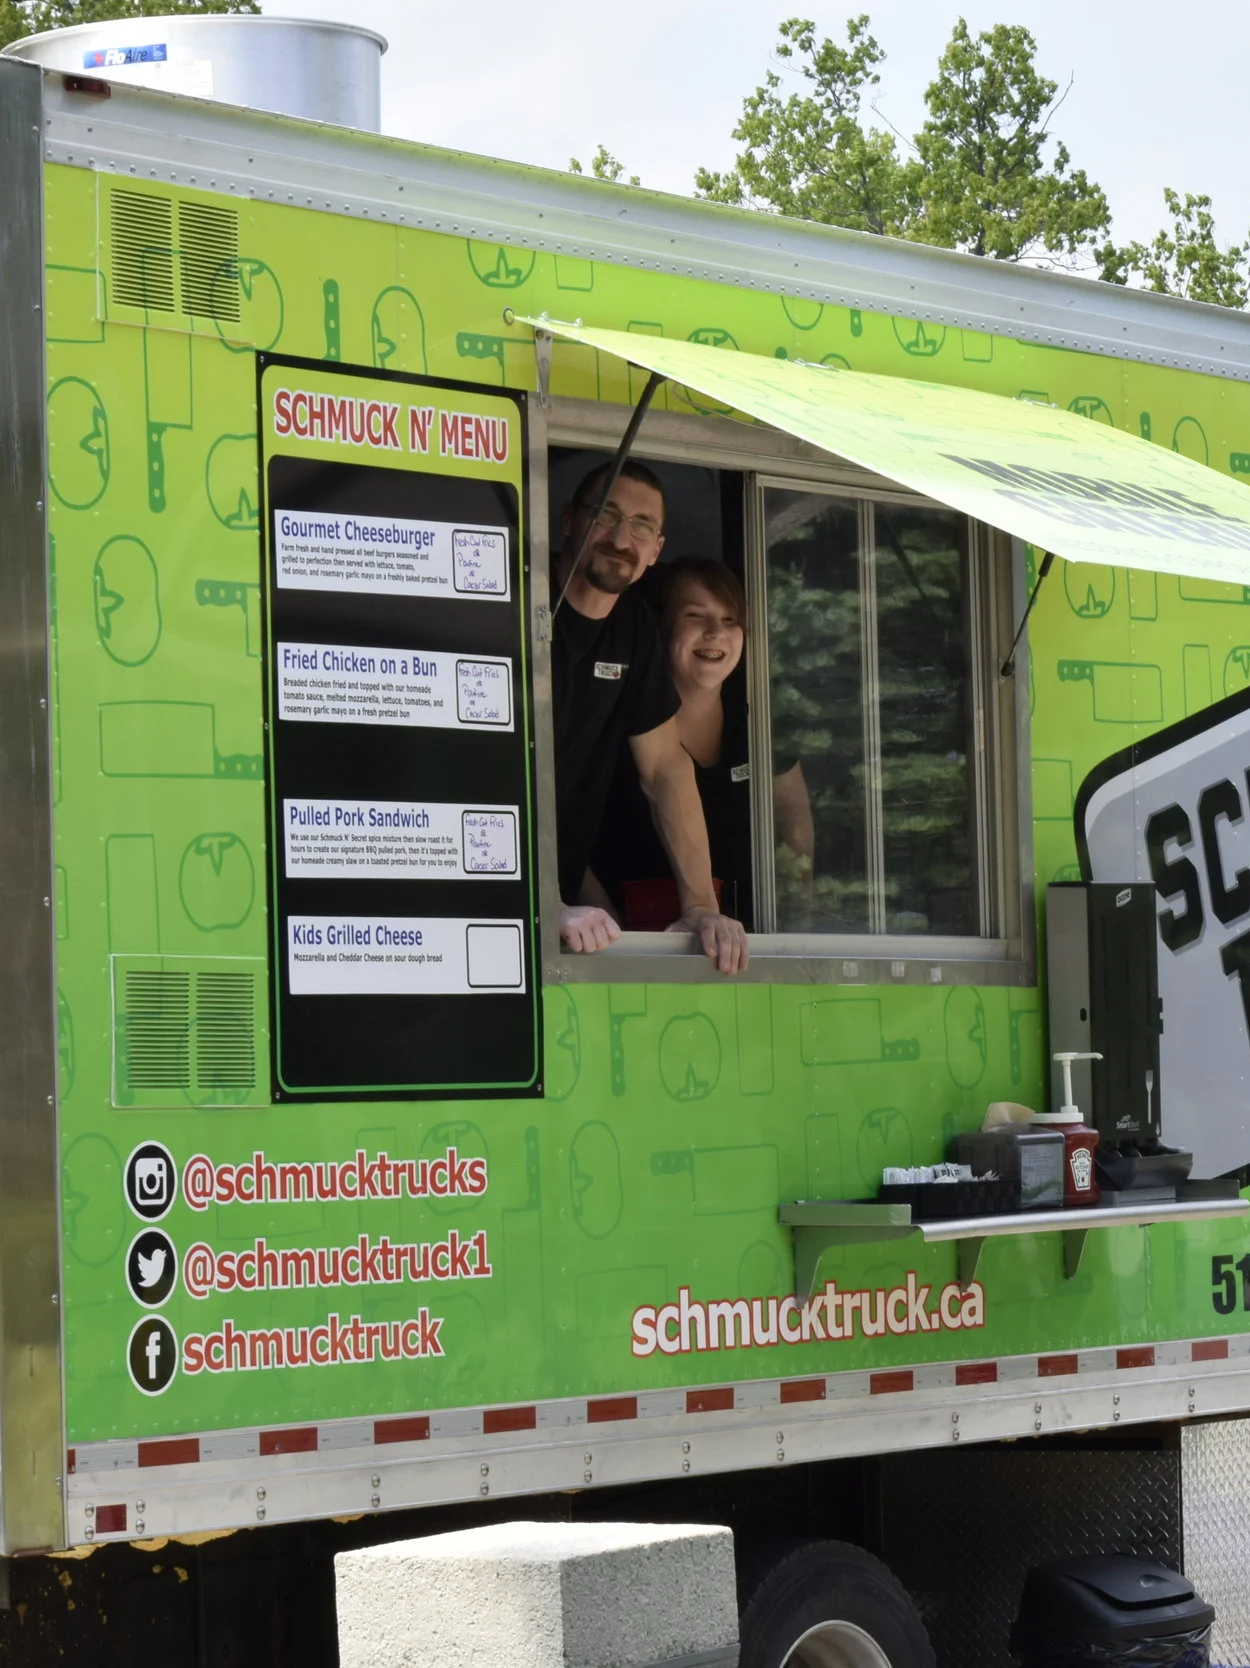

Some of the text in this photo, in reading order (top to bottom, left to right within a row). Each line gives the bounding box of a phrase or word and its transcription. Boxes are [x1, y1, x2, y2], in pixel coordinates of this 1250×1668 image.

[274, 389, 508, 463] SCHMUCK N' MENU
[936, 452, 1250, 525] MOBILE
[281, 516, 435, 550] Gourmet Cheeseburger
[281, 543, 294, 551] Farm
[296, 544, 309, 552] fresh
[311, 544, 320, 553] and
[321, 544, 333, 553] hand
[335, 546, 354, 556] pressed
[364, 548, 374, 556] beef
[376, 548, 395, 559] burgers
[396, 552, 418, 560] seasoned
[420, 552, 429, 560] and
[282, 555, 298, 565] grilled
[306, 555, 332, 567] perfection
[333, 558, 345, 566] then
[346, 559, 363, 567] served
[365, 560, 375, 568] with
[377, 560, 394, 570] lettuce,
[396, 562, 415, 572] tomato,
[284, 649, 437, 677] Fried Chicken on a Bun
[284, 678, 307, 687] Breaded
[309, 679, 331, 688] chicken
[333, 680, 346, 689] fried
[348, 681, 358, 689] and
[360, 682, 379, 691] topped
[382, 683, 394, 691] with
[406, 684, 431, 694] homeade
[284, 705, 311, 715] rosemary
[313, 705, 329, 716] garlic
[331, 708, 347, 717] mayo
[362, 707, 377, 716] fresh
[379, 709, 398, 718] pretzel
[399, 709, 410, 717] bun
[290, 806, 429, 828] Pulled Pork Sandwich
[320, 833, 343, 841] Schmuck
[351, 834, 367, 842] Secret
[368, 835, 381, 843] spice
[293, 924, 423, 945] Kids Grilled Cheese
[294, 953, 325, 962] Mozzarella
[326, 953, 337, 962] and
[339, 953, 362, 962] Cheddar
[364, 953, 384, 962] Cheese
[385, 954, 393, 962] on
[408, 954, 425, 964] dough
[427, 953, 443, 962] bread
[183, 1148, 487, 1211] @schmucktrucks
[183, 1230, 491, 1299] @schmucktruck1
[631, 1271, 985, 1357] schmucktruck.ca
[182, 1308, 445, 1374] schmucktruck
